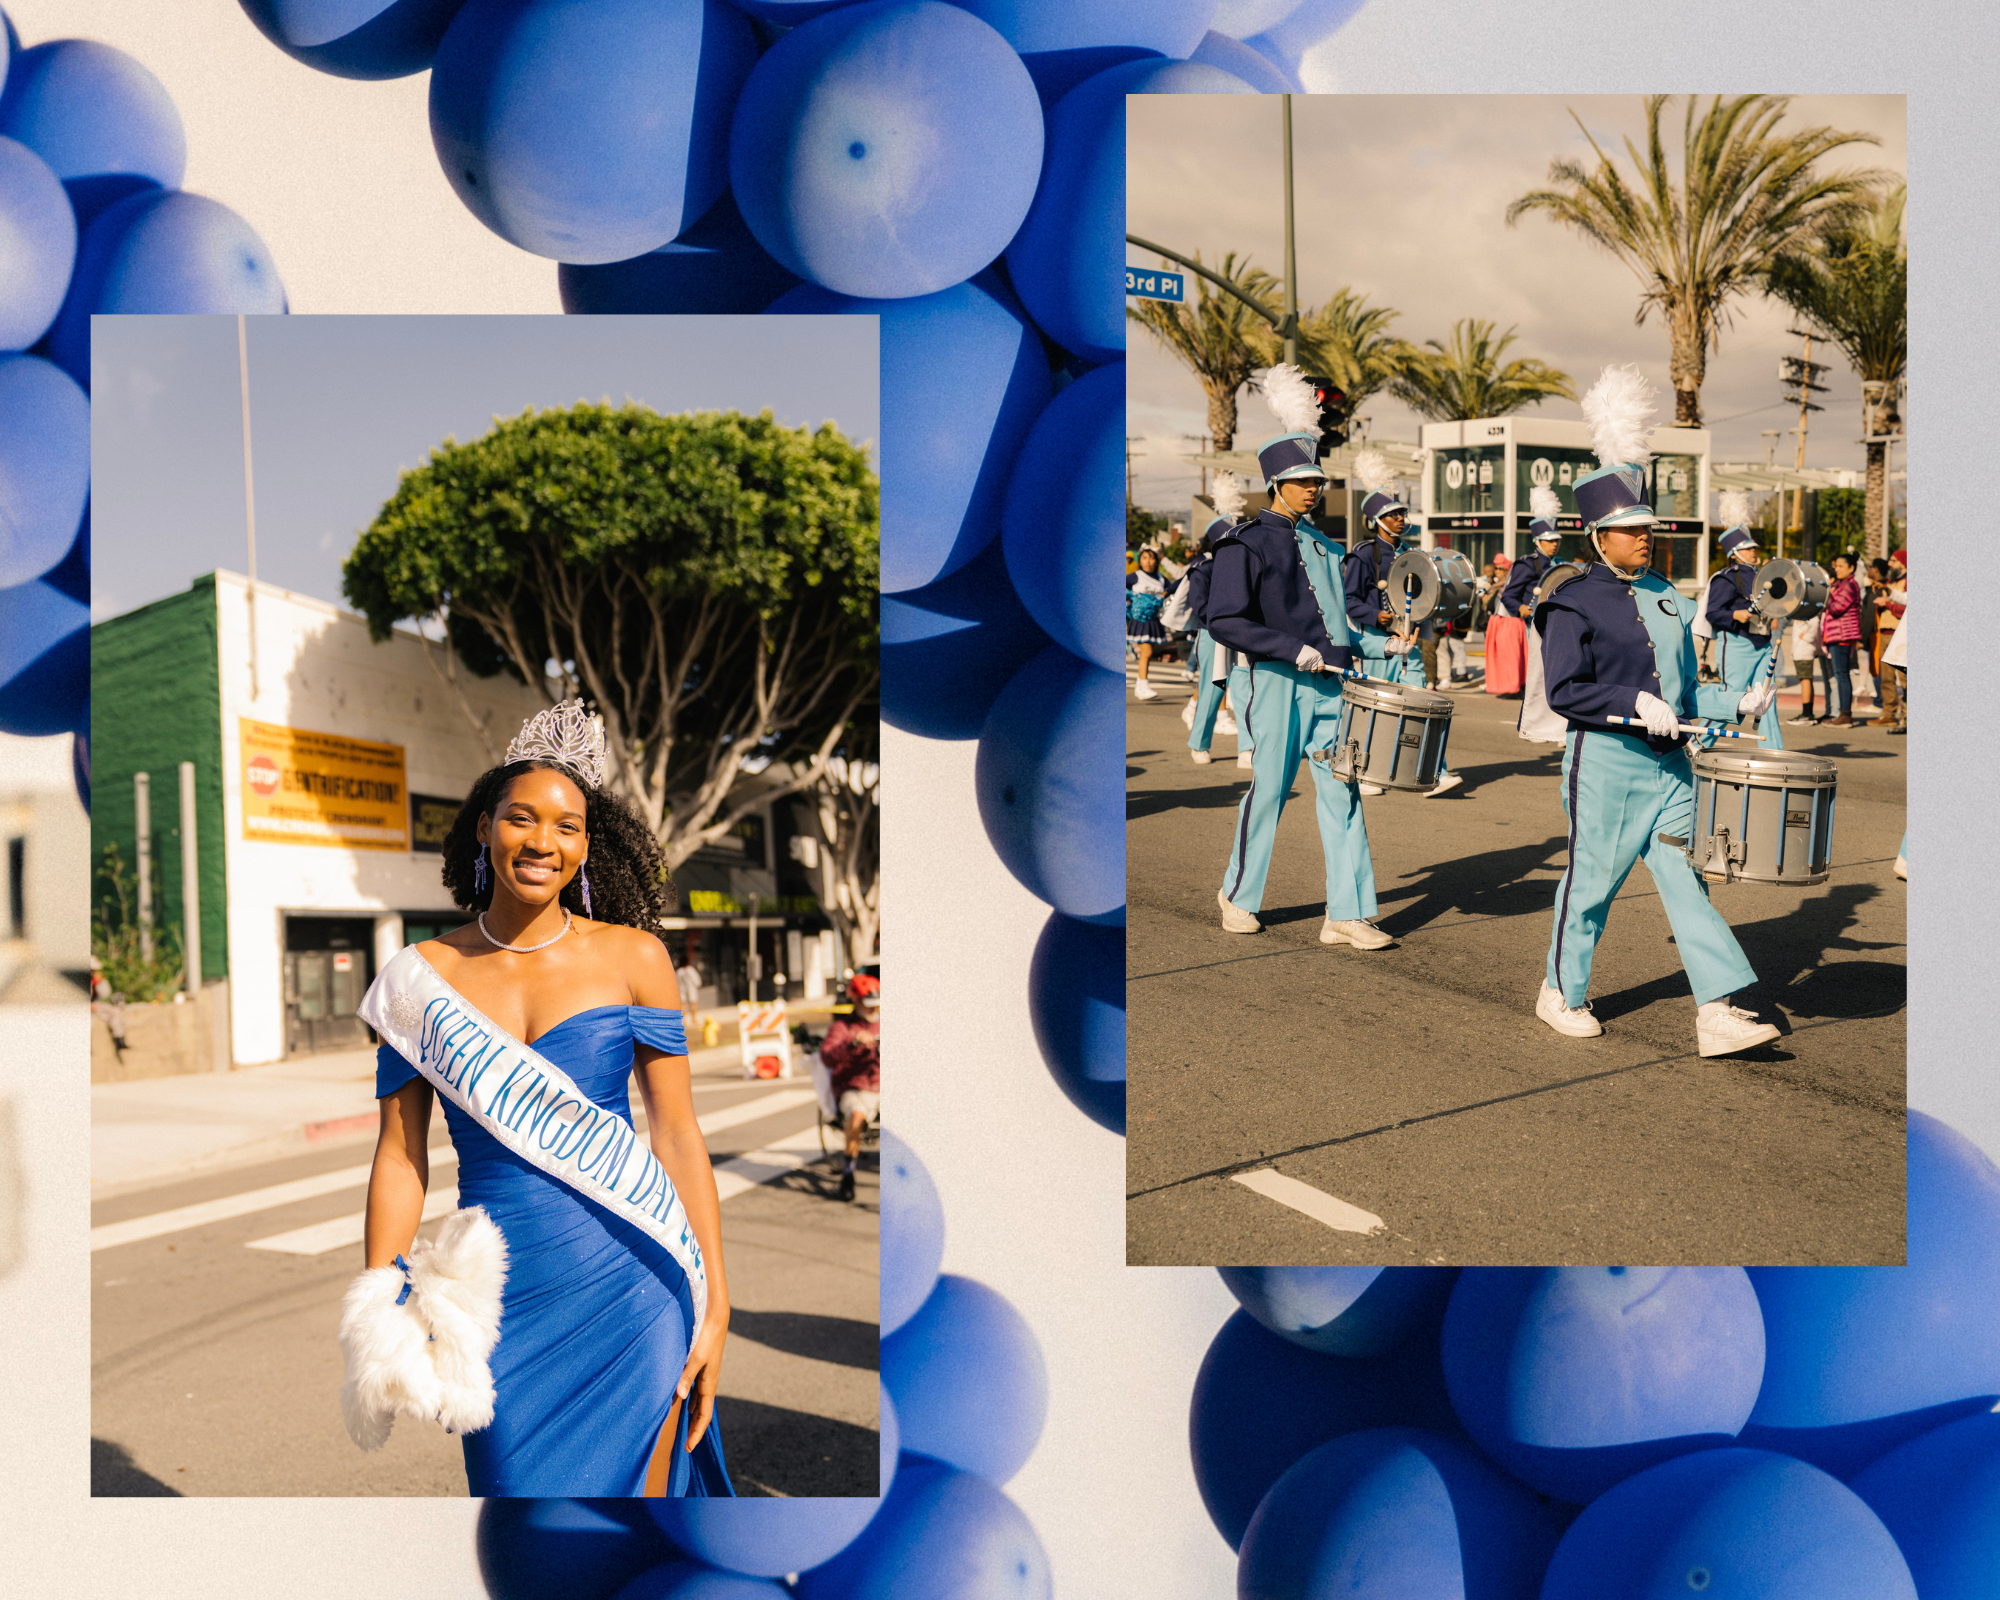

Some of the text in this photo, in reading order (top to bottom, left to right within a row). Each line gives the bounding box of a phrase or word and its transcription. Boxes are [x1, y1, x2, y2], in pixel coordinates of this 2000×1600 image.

[1126, 272, 1178, 295] 3rd Pl
[1313, 540, 1326, 557] C
[1656, 599, 1679, 617] C
[246, 765, 281, 787] STOP
[421, 997, 508, 1102] QUEEN
[484, 1058, 636, 1192] KINGDOM
